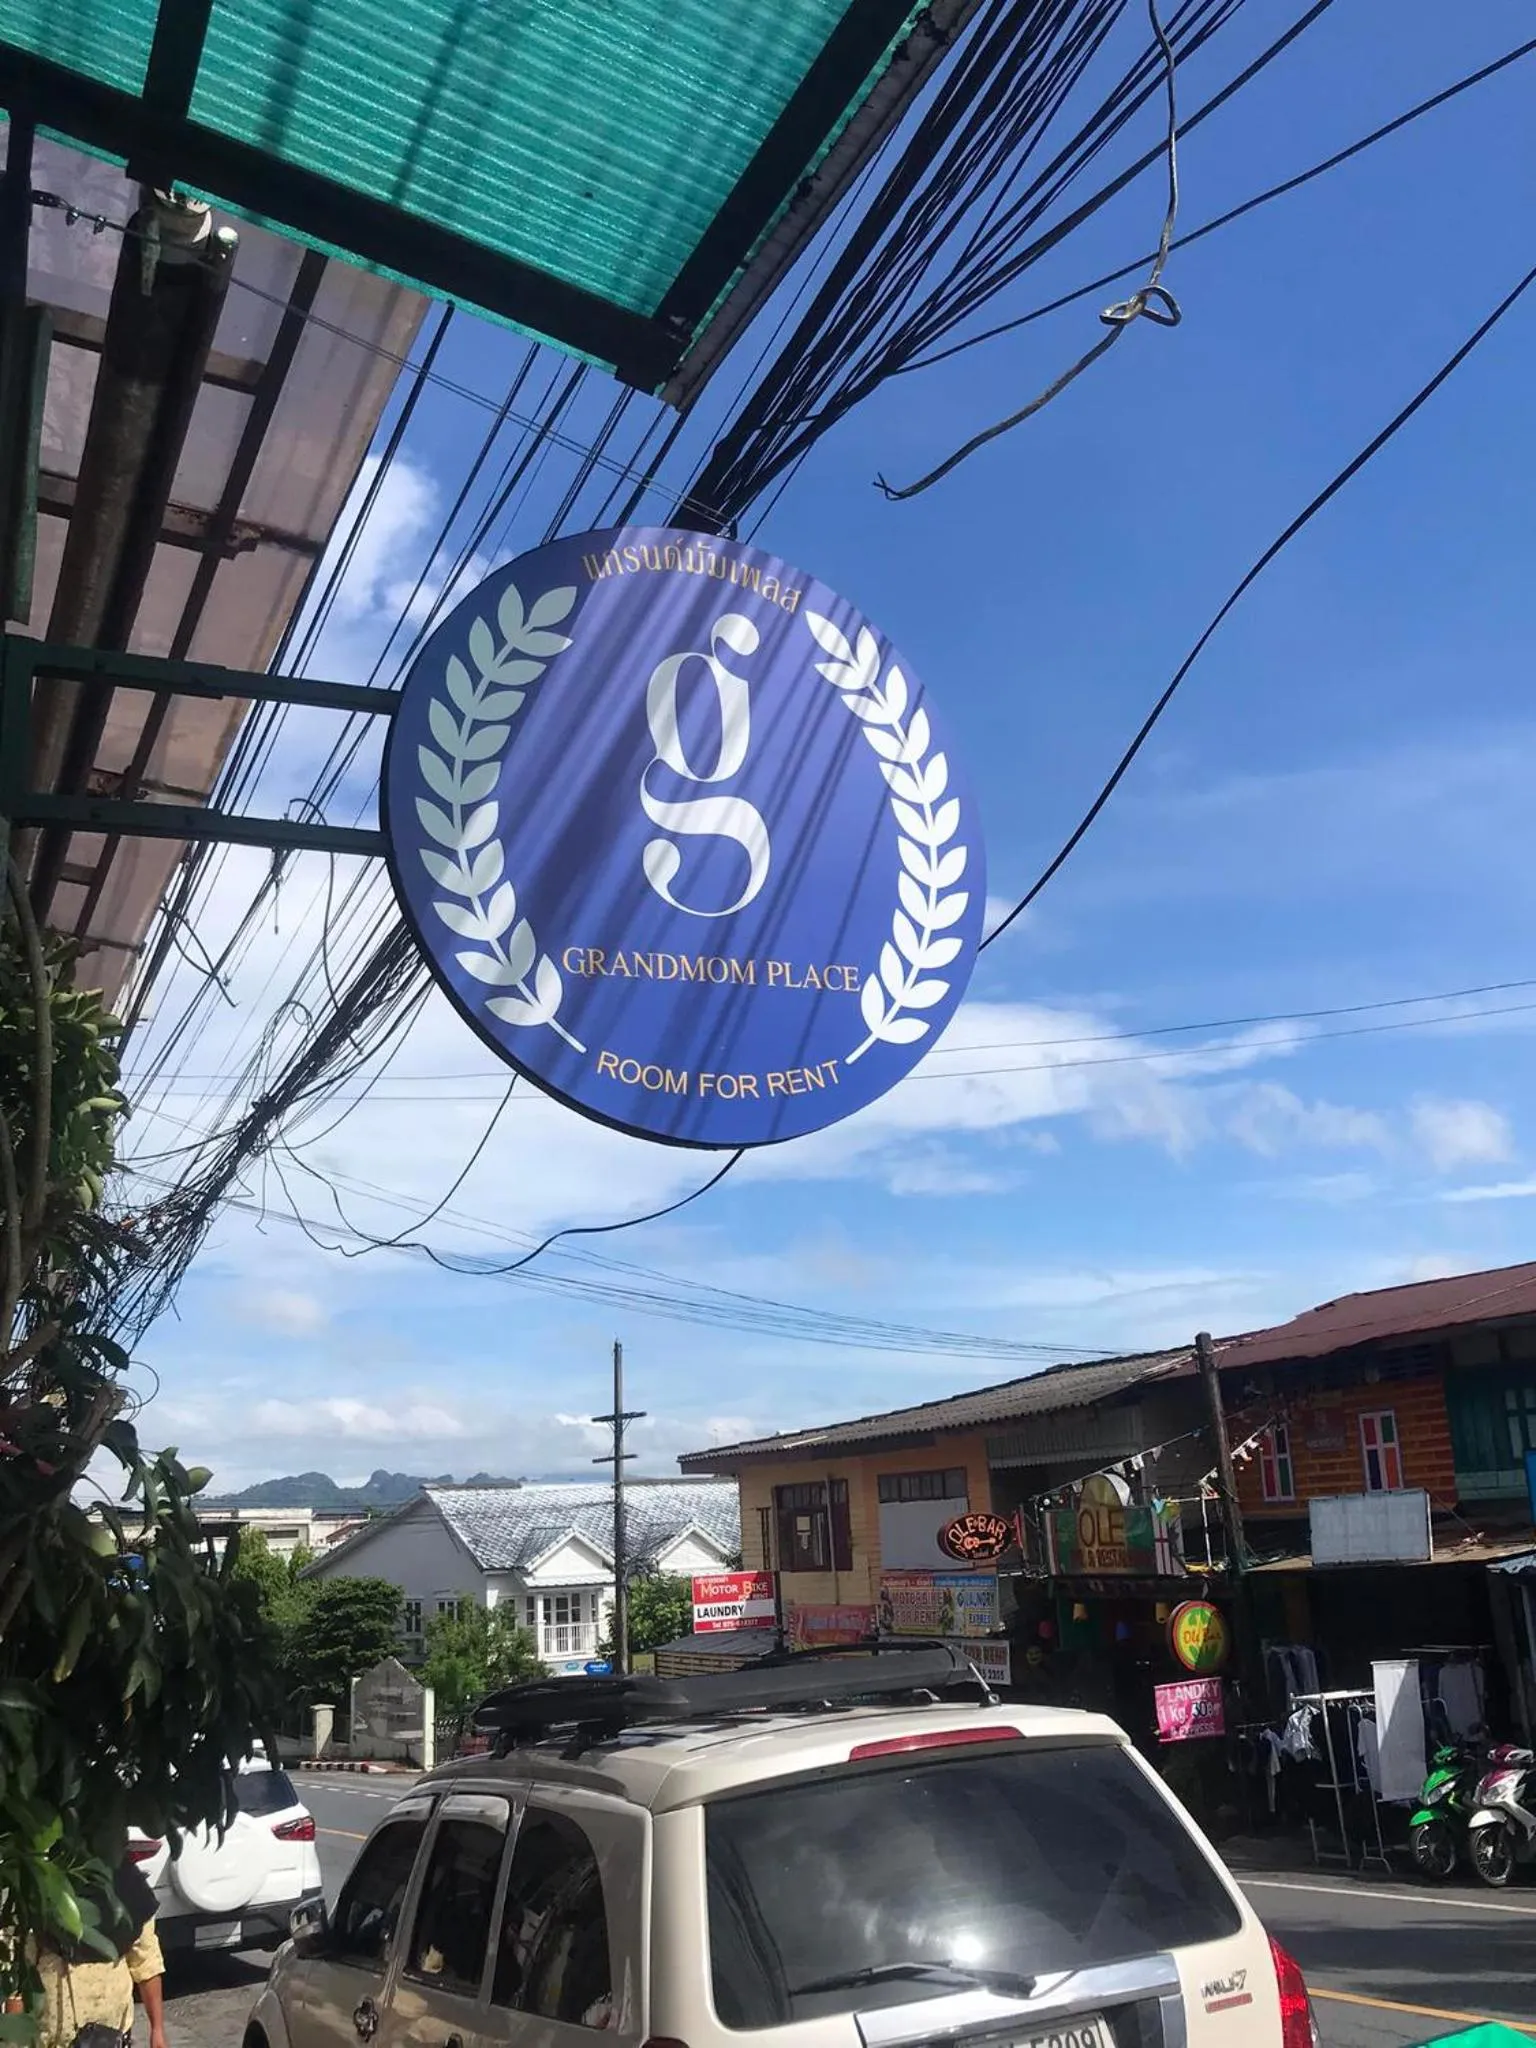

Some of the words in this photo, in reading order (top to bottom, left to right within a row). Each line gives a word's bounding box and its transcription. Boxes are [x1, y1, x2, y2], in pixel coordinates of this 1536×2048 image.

[562, 947, 755, 985] GRANDMOM
[767, 960, 861, 992] PLACE
[597, 1051, 688, 1094] ROOM
[700, 1073, 760, 1099] FOR
[766, 1060, 840, 1098] RENT
[701, 1583, 739, 1598] MOTOR
[743, 1580, 768, 1594] BIKE
[696, 1604, 745, 1619] LAUNDRY
[1166, 1681, 1219, 1702] LANDRY
